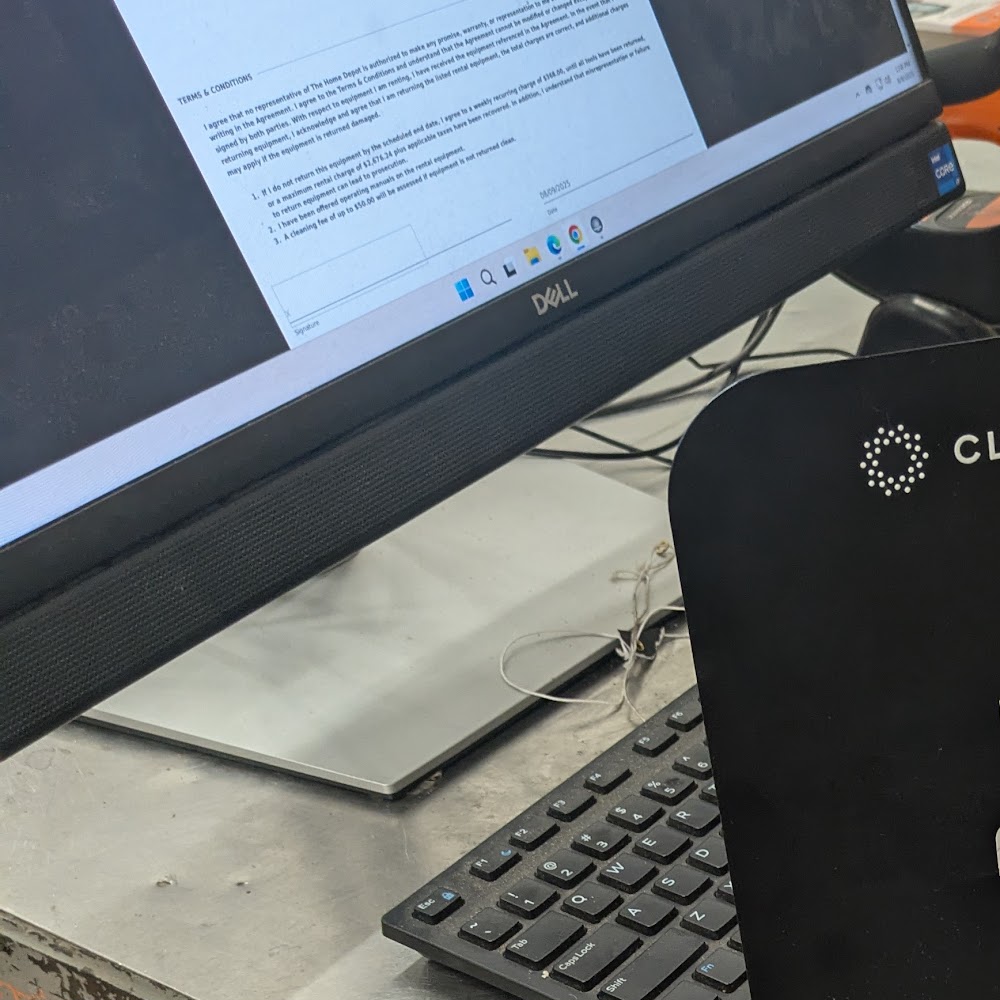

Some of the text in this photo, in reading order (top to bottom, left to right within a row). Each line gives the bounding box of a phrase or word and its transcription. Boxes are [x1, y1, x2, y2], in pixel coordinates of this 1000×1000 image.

[208, 117, 228, 129] agree
[228, 110, 244, 121] that
[254, 90, 302, 112] representative
[309, 82, 323, 90] The
[323, 75, 342, 86] Home
[342, 67, 362, 79] Depot
[368, 51, 401, 69] authorized
[408, 44, 425, 54] make
[425, 40, 437, 48] any
[437, 31, 462, 45] promise,
[462, 21, 489, 34] warranty,
[177, 91, 203, 105] TERMS
[210, 73, 253, 94] CONDITIONS
[226, 166, 242, 177] may
[242, 158, 261, 171] apply
[267, 151, 280, 160] the
[280, 137, 316, 155] equipment
[322, 122, 351, 139] returned
[350, 111, 381, 128] damaged.
[280, 202, 302, 215] return
[302, 186, 336, 206] equipment
[336, 182, 349, 191] can
[348, 175, 363, 186] lead
[371, 158, 408, 178] prosecution.
[281, 217, 298, 228] have
[298, 210, 316, 221] been
[316, 198, 339, 213] offered
[339, 187, 370, 203] operating
[369, 175, 395, 190] manuals
[403, 167, 415, 176] the
[415, 158, 433, 171] rental
[433, 145, 465, 163] equipment.
[289, 222, 318, 238] cleaning
[317, 217, 328, 226] fee
[354, 196, 375, 210] $50.00
[375, 191, 387, 201] will
[396, 175, 423, 192] assessed
[428, 160, 459, 178] equipment
[465, 153, 476, 162] not
[475, 142, 500, 157] returned
[500, 137, 516, 147] clean.
[530, 278, 579, 316] DELL
[294, 320, 319, 336] Signature
[589, 772, 602, 782] F4
[663, 787, 676, 796] 5
[632, 812, 643, 822] 4
[676, 810, 692, 820] R
[514, 828, 528, 838] F2
[580, 833, 592, 843] #
[596, 839, 609, 849] 3
[641, 837, 657, 848] E
[695, 848, 710, 859] D
[475, 858, 488, 868] F1
[543, 861, 558, 871] @
[605, 861, 625, 876] W
[561, 868, 575, 878] 2
[661, 877, 676, 888] S
[418, 898, 436, 911] Esc
[571, 895, 588, 905] Q
[627, 906, 642, 917] A
[689, 910, 706, 922] Z
[510, 938, 528, 951] Tab
[557, 941, 596, 972] Caps Lock
[700, 962, 715, 974] Fn
[605, 976, 628, 994] Shift
